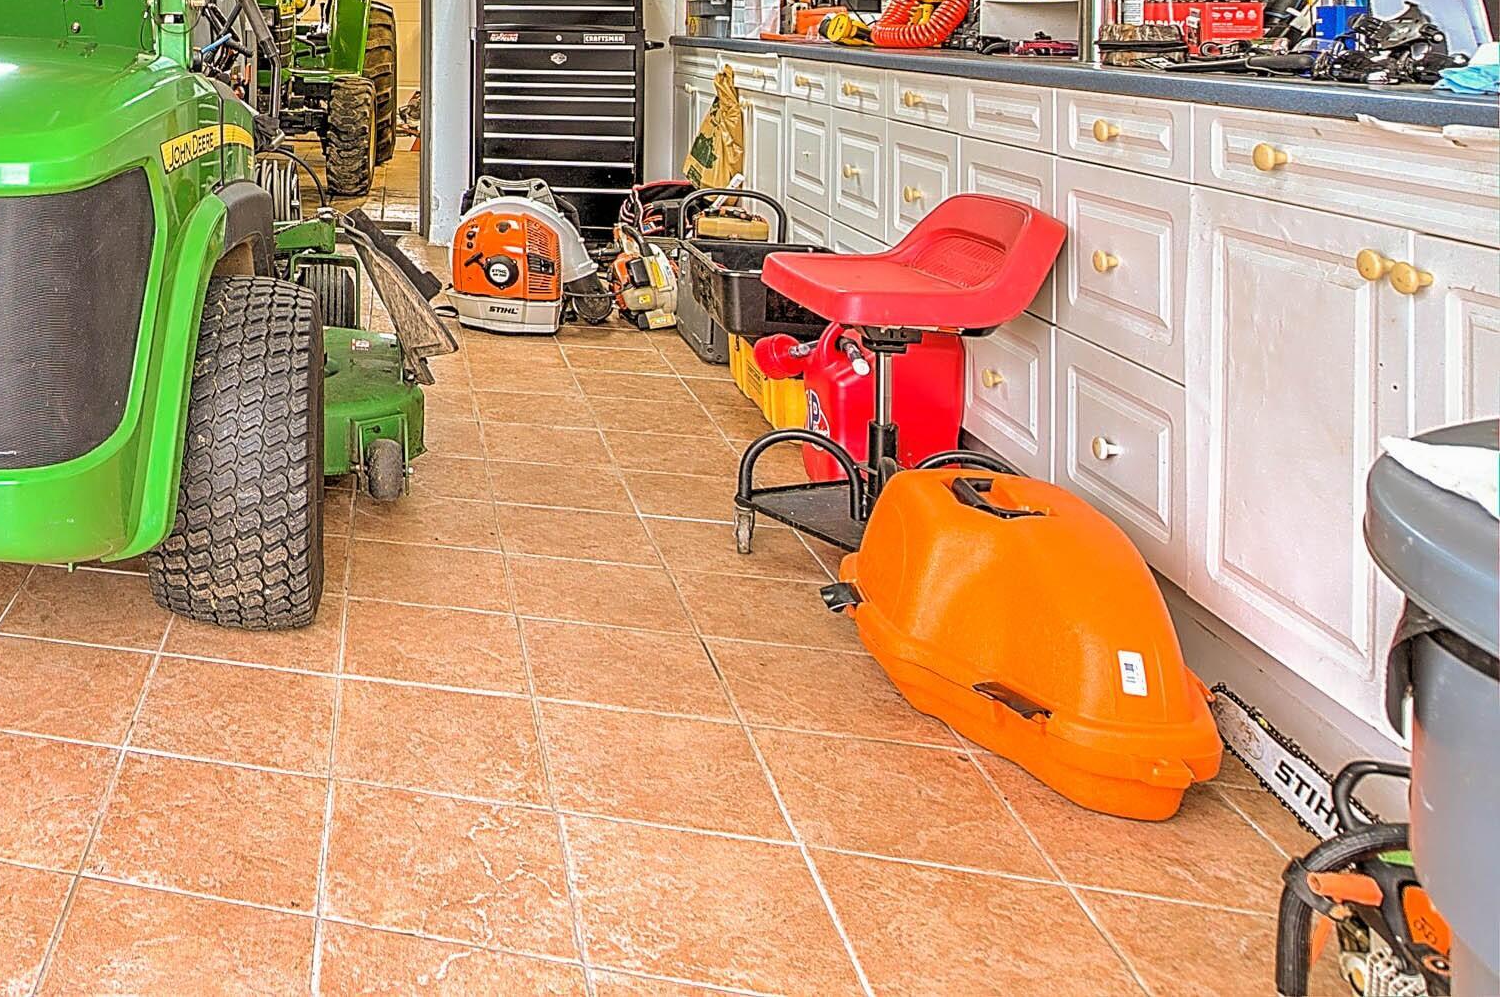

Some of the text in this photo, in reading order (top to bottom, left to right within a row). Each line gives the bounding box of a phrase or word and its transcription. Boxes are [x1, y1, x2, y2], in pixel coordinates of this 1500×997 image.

[585, 35, 624, 43] CRAFTSMAN
[169, 132, 214, 167] JOHN DEERE
[489, 305, 518, 315] STIHL
[1274, 759, 1343, 834] STIH
